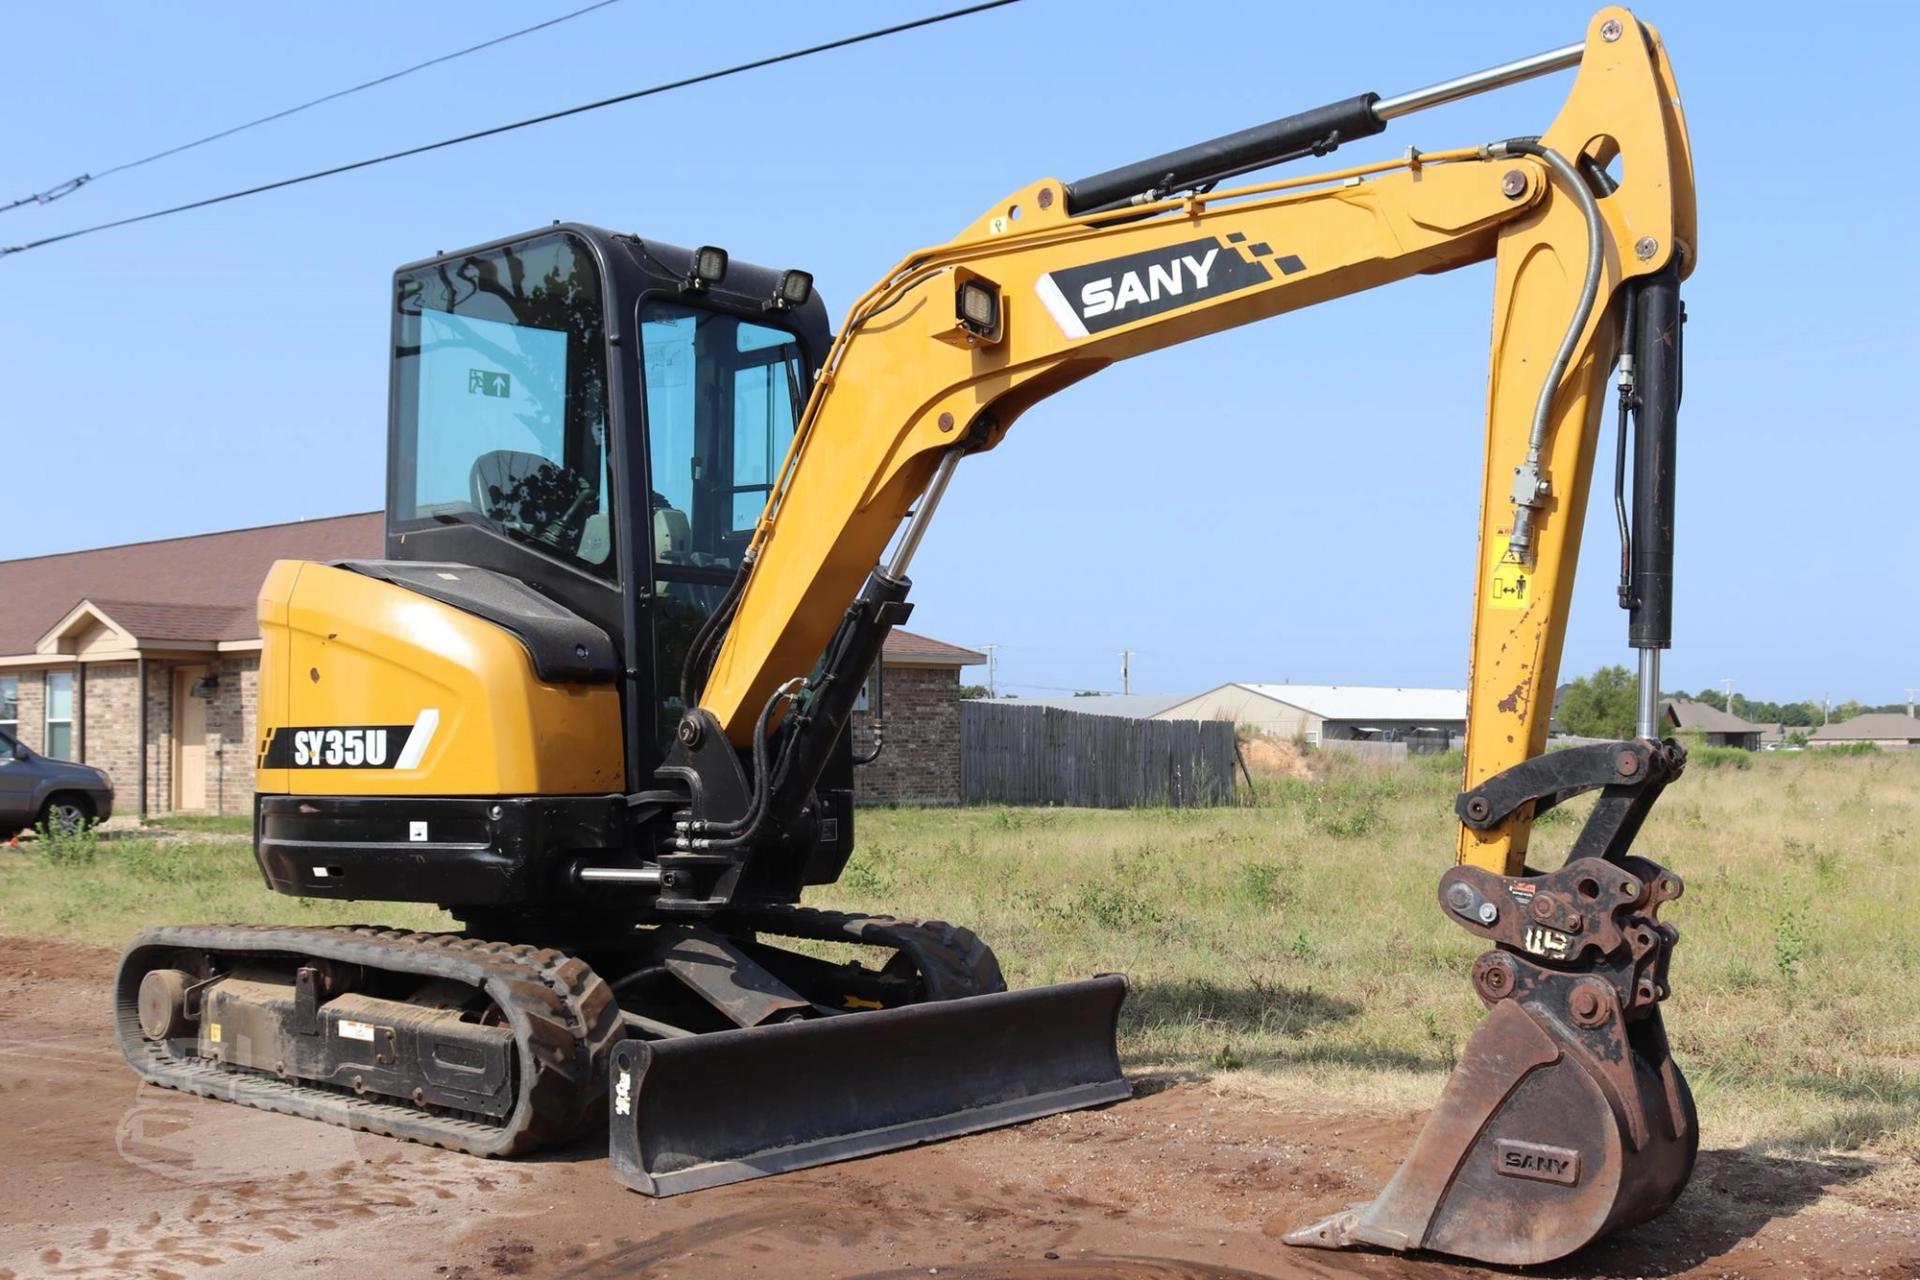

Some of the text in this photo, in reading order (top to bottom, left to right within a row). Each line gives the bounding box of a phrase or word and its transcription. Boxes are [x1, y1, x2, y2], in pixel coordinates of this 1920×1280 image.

[1081, 248, 1219, 319] SANY
[294, 729, 388, 766] SY35U
[1505, 1151, 1570, 1175] SANY
